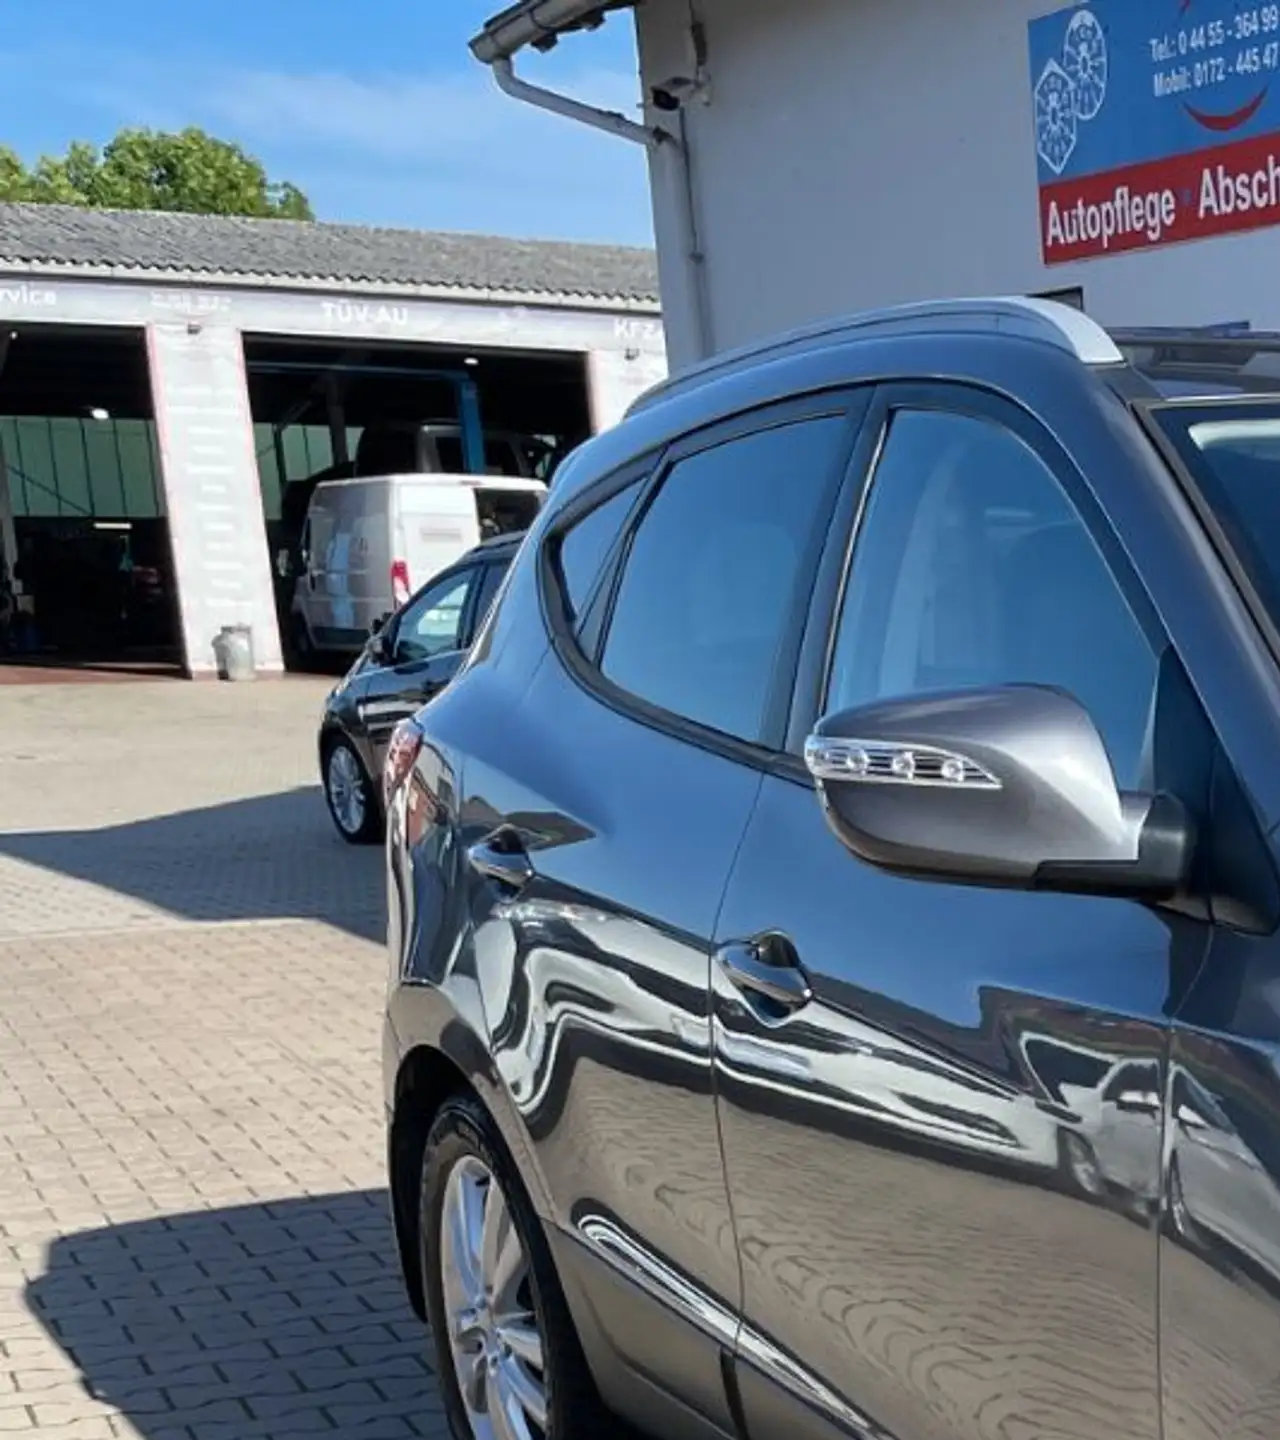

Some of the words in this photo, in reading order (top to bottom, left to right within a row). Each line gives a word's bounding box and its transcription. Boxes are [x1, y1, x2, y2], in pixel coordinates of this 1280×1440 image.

[1208, 20, 1224, 48] 55
[1234, 10, 1259, 40] 364
[1153, 67, 1191, 97] Mobil:
[1194, 56, 1225, 87] 0172
[1236, 47, 1260, 77] 445
[1262, 41, 1279, 69] 47
[1047, 184, 1176, 248] Autopflege
